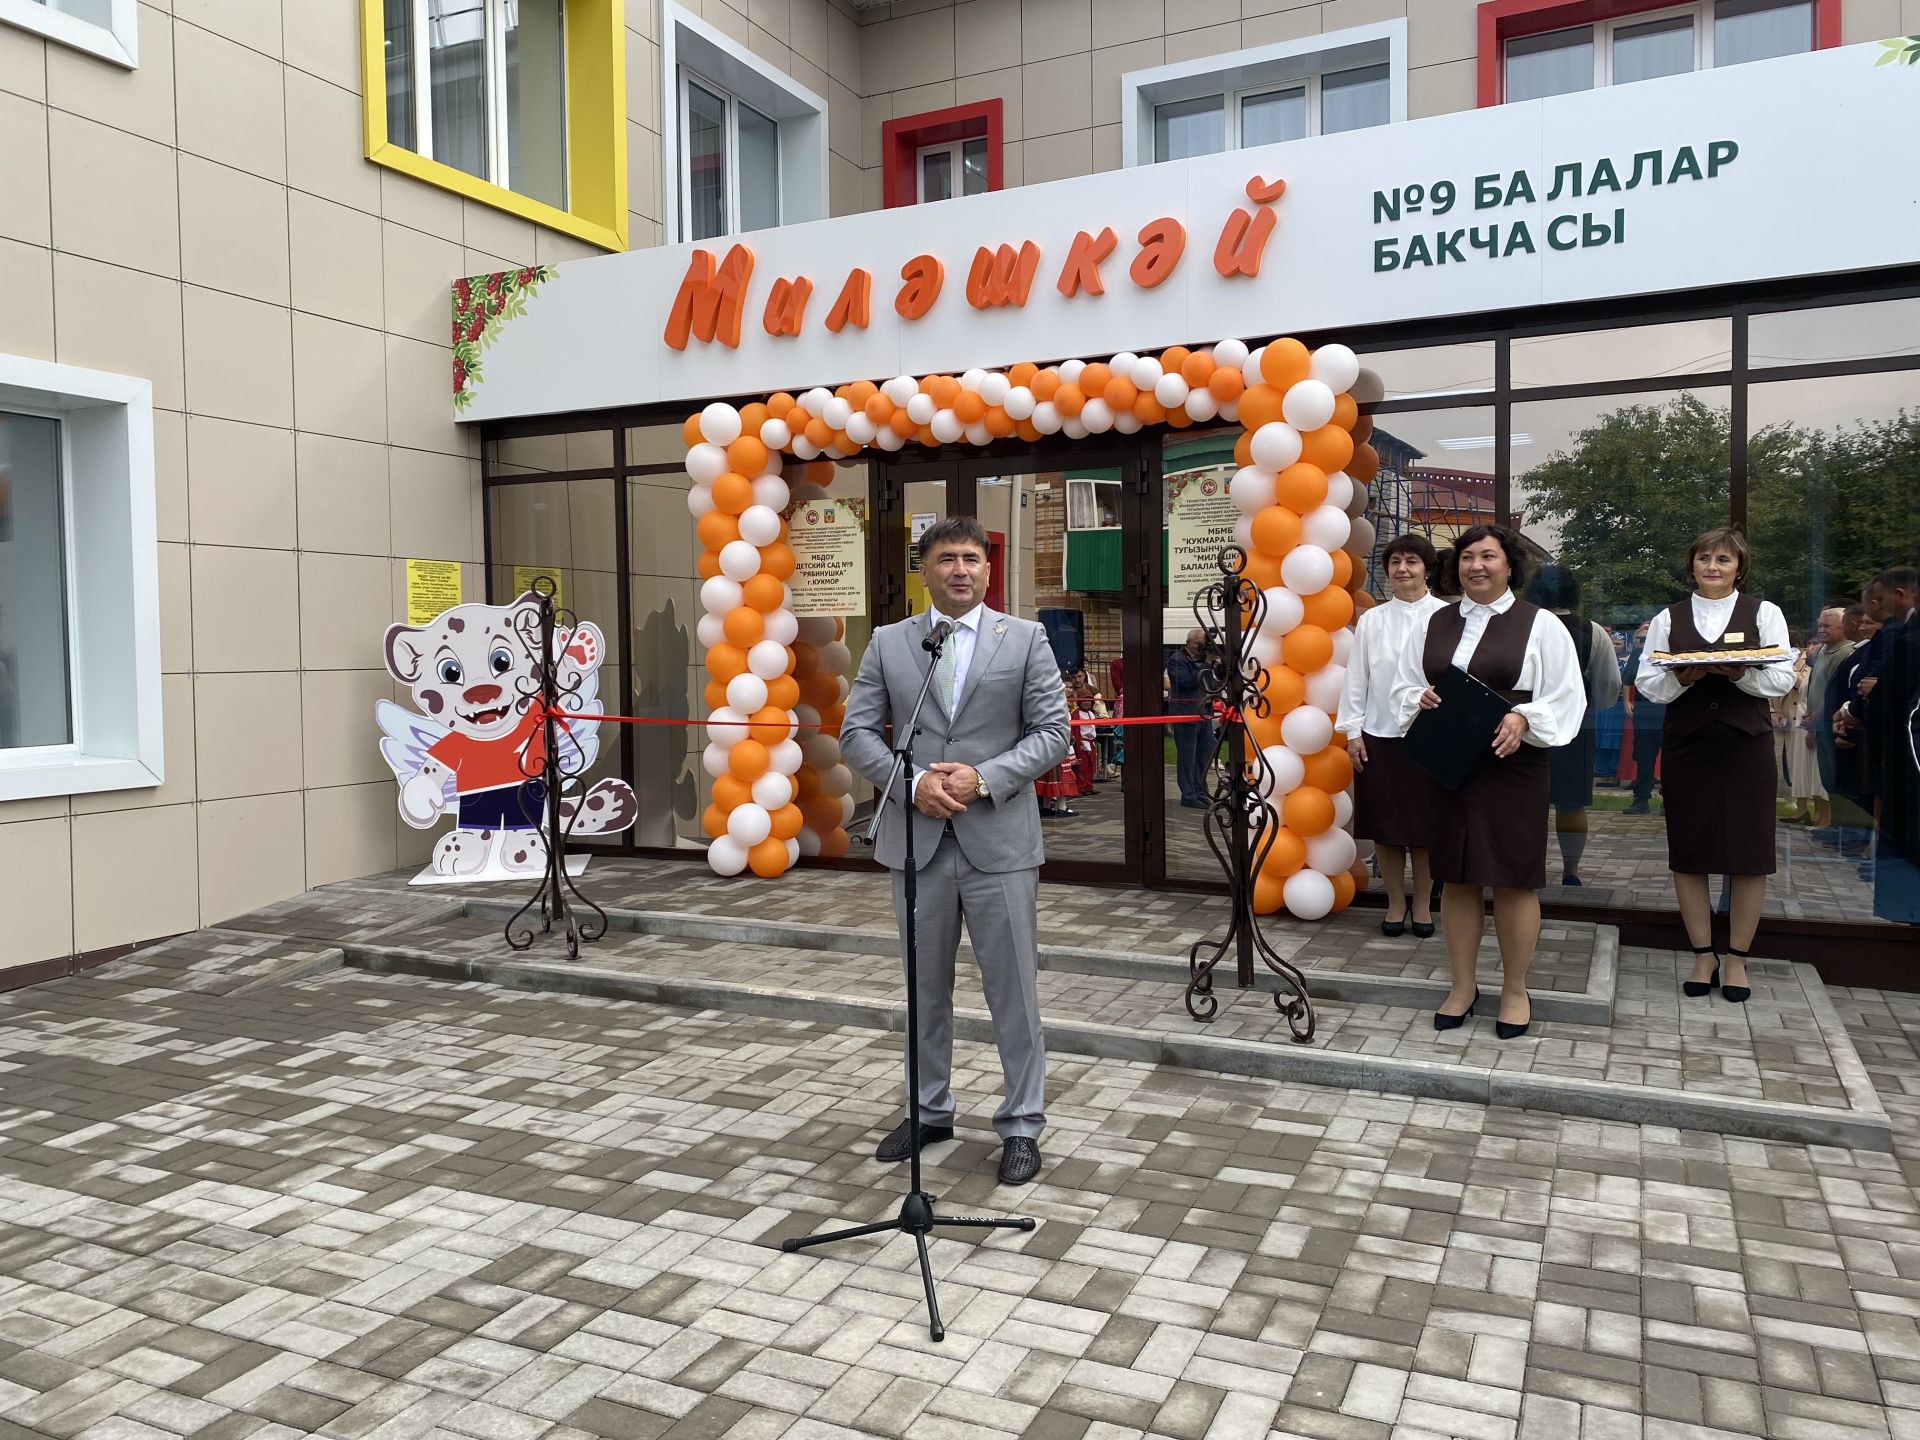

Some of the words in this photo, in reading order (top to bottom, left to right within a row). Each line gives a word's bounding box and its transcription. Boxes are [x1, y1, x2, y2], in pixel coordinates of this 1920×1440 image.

[1373, 179, 1456, 224] №9
[1373, 208, 1625, 274] БАКЧАСЫ
[796, 561, 826, 570] ДЕТСКИЙ
[827, 561, 840, 569] САД
[811, 554, 834, 562] МБДОУ
